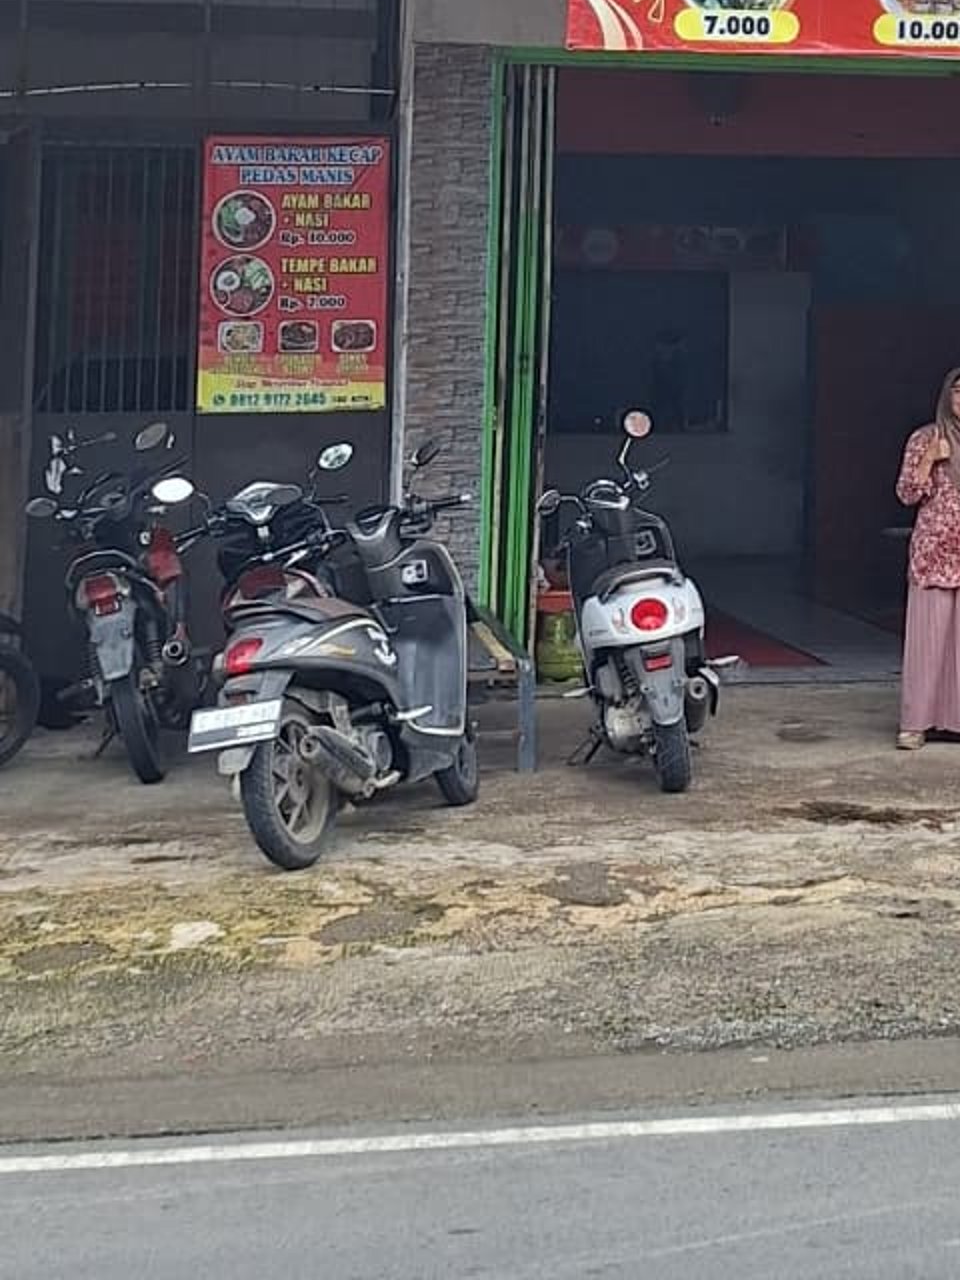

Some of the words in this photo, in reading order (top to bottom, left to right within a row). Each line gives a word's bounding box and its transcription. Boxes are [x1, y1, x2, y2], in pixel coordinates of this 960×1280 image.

[704, 15, 770, 36] 7.000
[212, 145, 260, 165] AYAM
[264, 146, 324, 164] BAKAR
[240, 166, 299, 185] PEDAS
[301, 166, 355, 185] MANIS
[281, 194, 319, 209] AYAM
[323, 193, 371, 209] BAKAR
[295, 212, 330, 227] NASI
[280, 258, 325, 273] TEMPE
[329, 257, 377, 273] BAKAR
[293, 277, 327, 292] NASI
